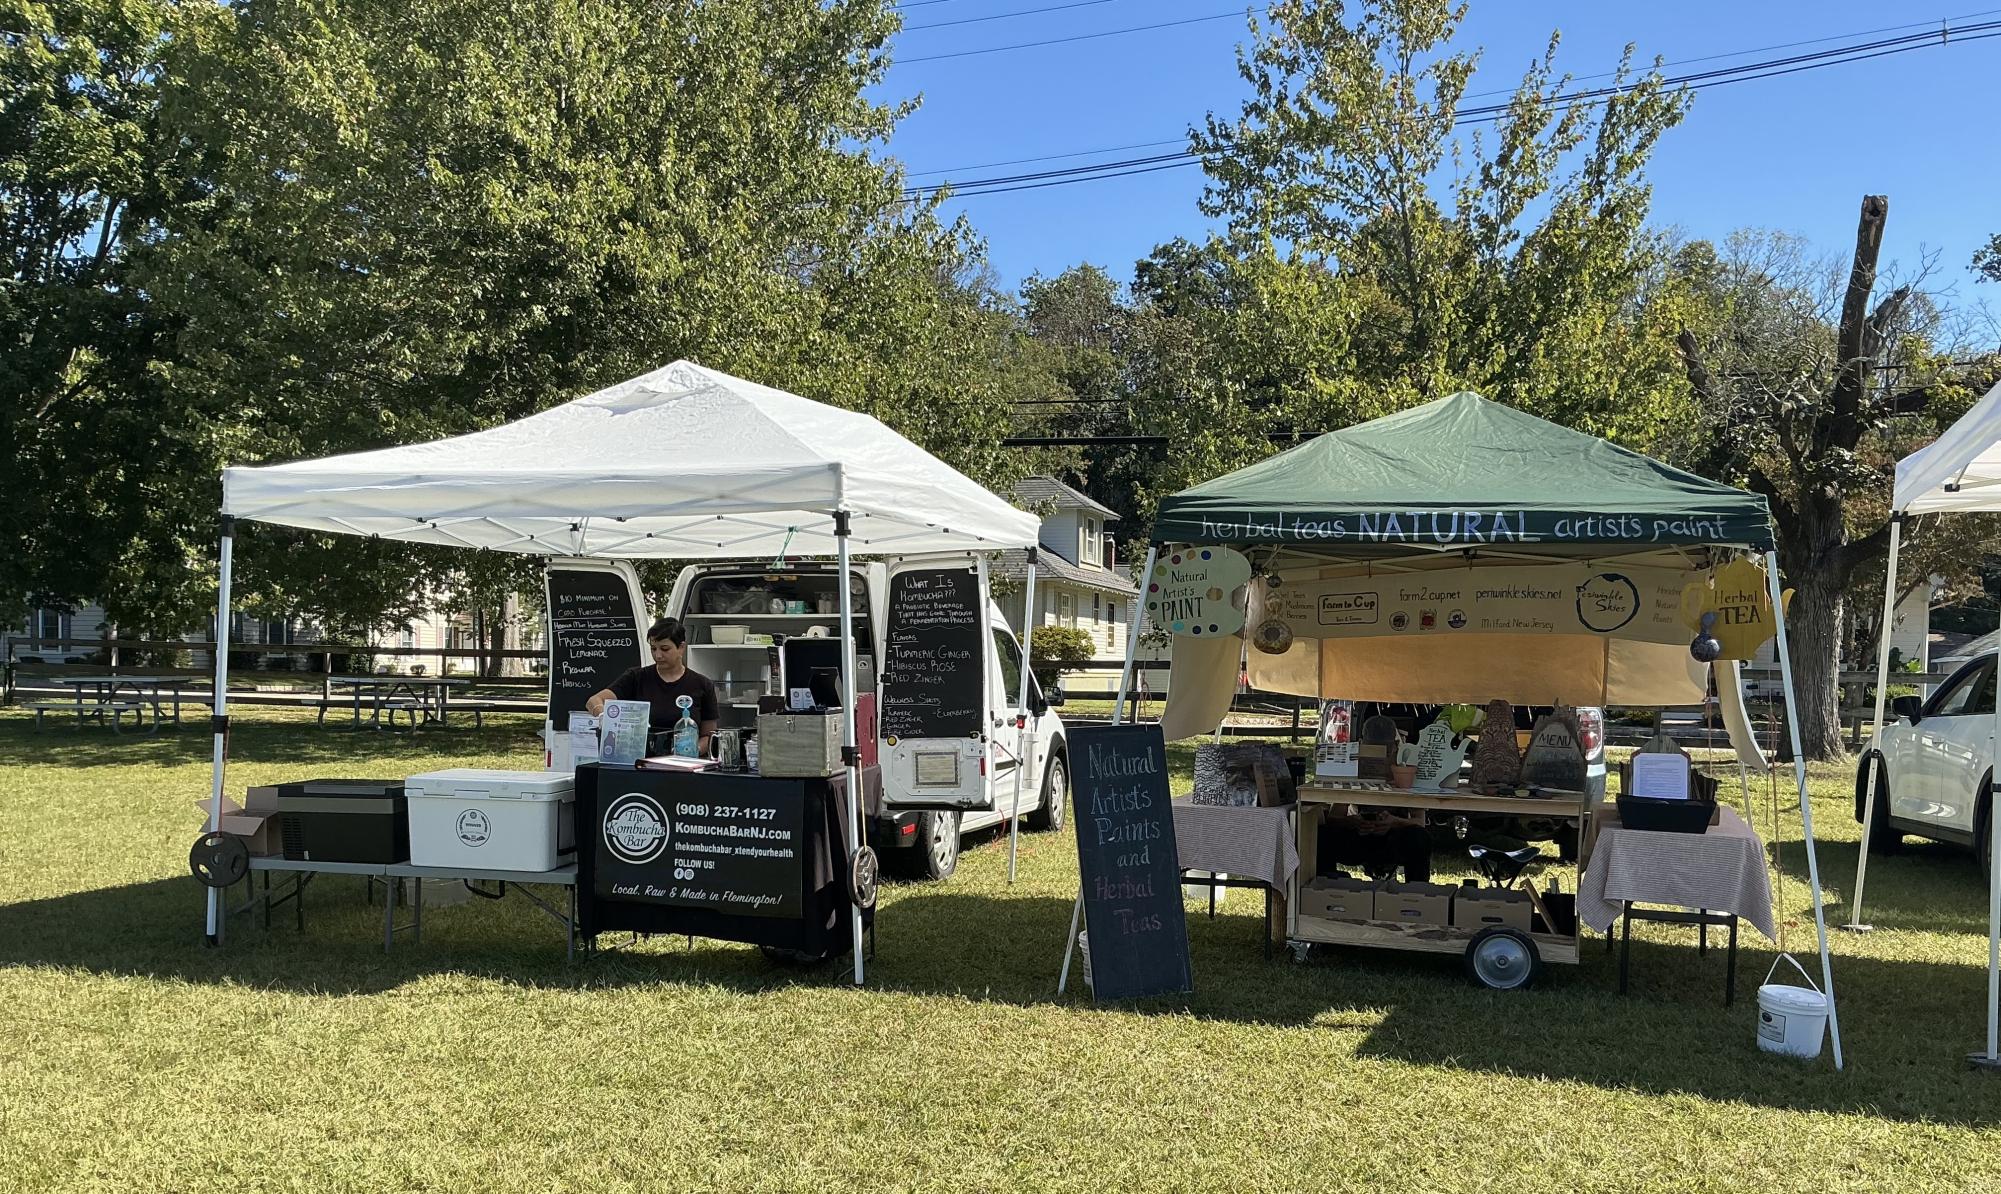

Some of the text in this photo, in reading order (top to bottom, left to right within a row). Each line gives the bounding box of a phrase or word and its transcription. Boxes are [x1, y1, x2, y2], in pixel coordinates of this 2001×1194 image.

[1200, 511, 1730, 542] herbal teas NATURAL artist's paint
[905, 574, 954, 589] WHAT IS
[1171, 568, 1208, 584] Natural
[575, 594, 605, 602] MINIMUM
[1162, 586, 1195, 600] Artist's
[1713, 589, 1758, 605] Herbal
[1161, 596, 1203, 622] PAINT
[1353, 595, 1376, 610] Cup
[1594, 598, 1627, 613] Skies
[1718, 605, 1761, 625] TEA
[1512, 617, 1530, 628] New
[1531, 617, 1554, 632] Jersey
[557, 631, 633, 648] FRESH SQUEEZED
[569, 648, 608, 659] LEMONADE
[891, 644, 971, 659] TURMERIC GINGER
[891, 659, 957, 672] HIBISCUS ROSE
[561, 677, 592, 689] HIBISCUS
[890, 671, 945, 684] RED ZINGER
[1426, 733, 1446, 744] TEA
[1539, 732, 1573, 747] MENU
[1088, 744, 1158, 779] Natural
[625, 809, 646, 823] The
[675, 802, 777, 820] (908) 237-1127
[606, 820, 666, 837] Kombucha
[1094, 817, 1161, 845] Paints
[624, 836, 647, 848] Bar
[1116, 844, 1151, 867] and
[674, 858, 716, 870] FOLLOW US!
[1094, 876, 1155, 900] Herbal
[644, 885, 667, 897] Raw
[669, 886, 677, 898] &
[679, 887, 706, 900] Made
[709, 890, 720, 902] in
[721, 890, 783, 909] Flemington!
[1113, 908, 1163, 935] Teas
